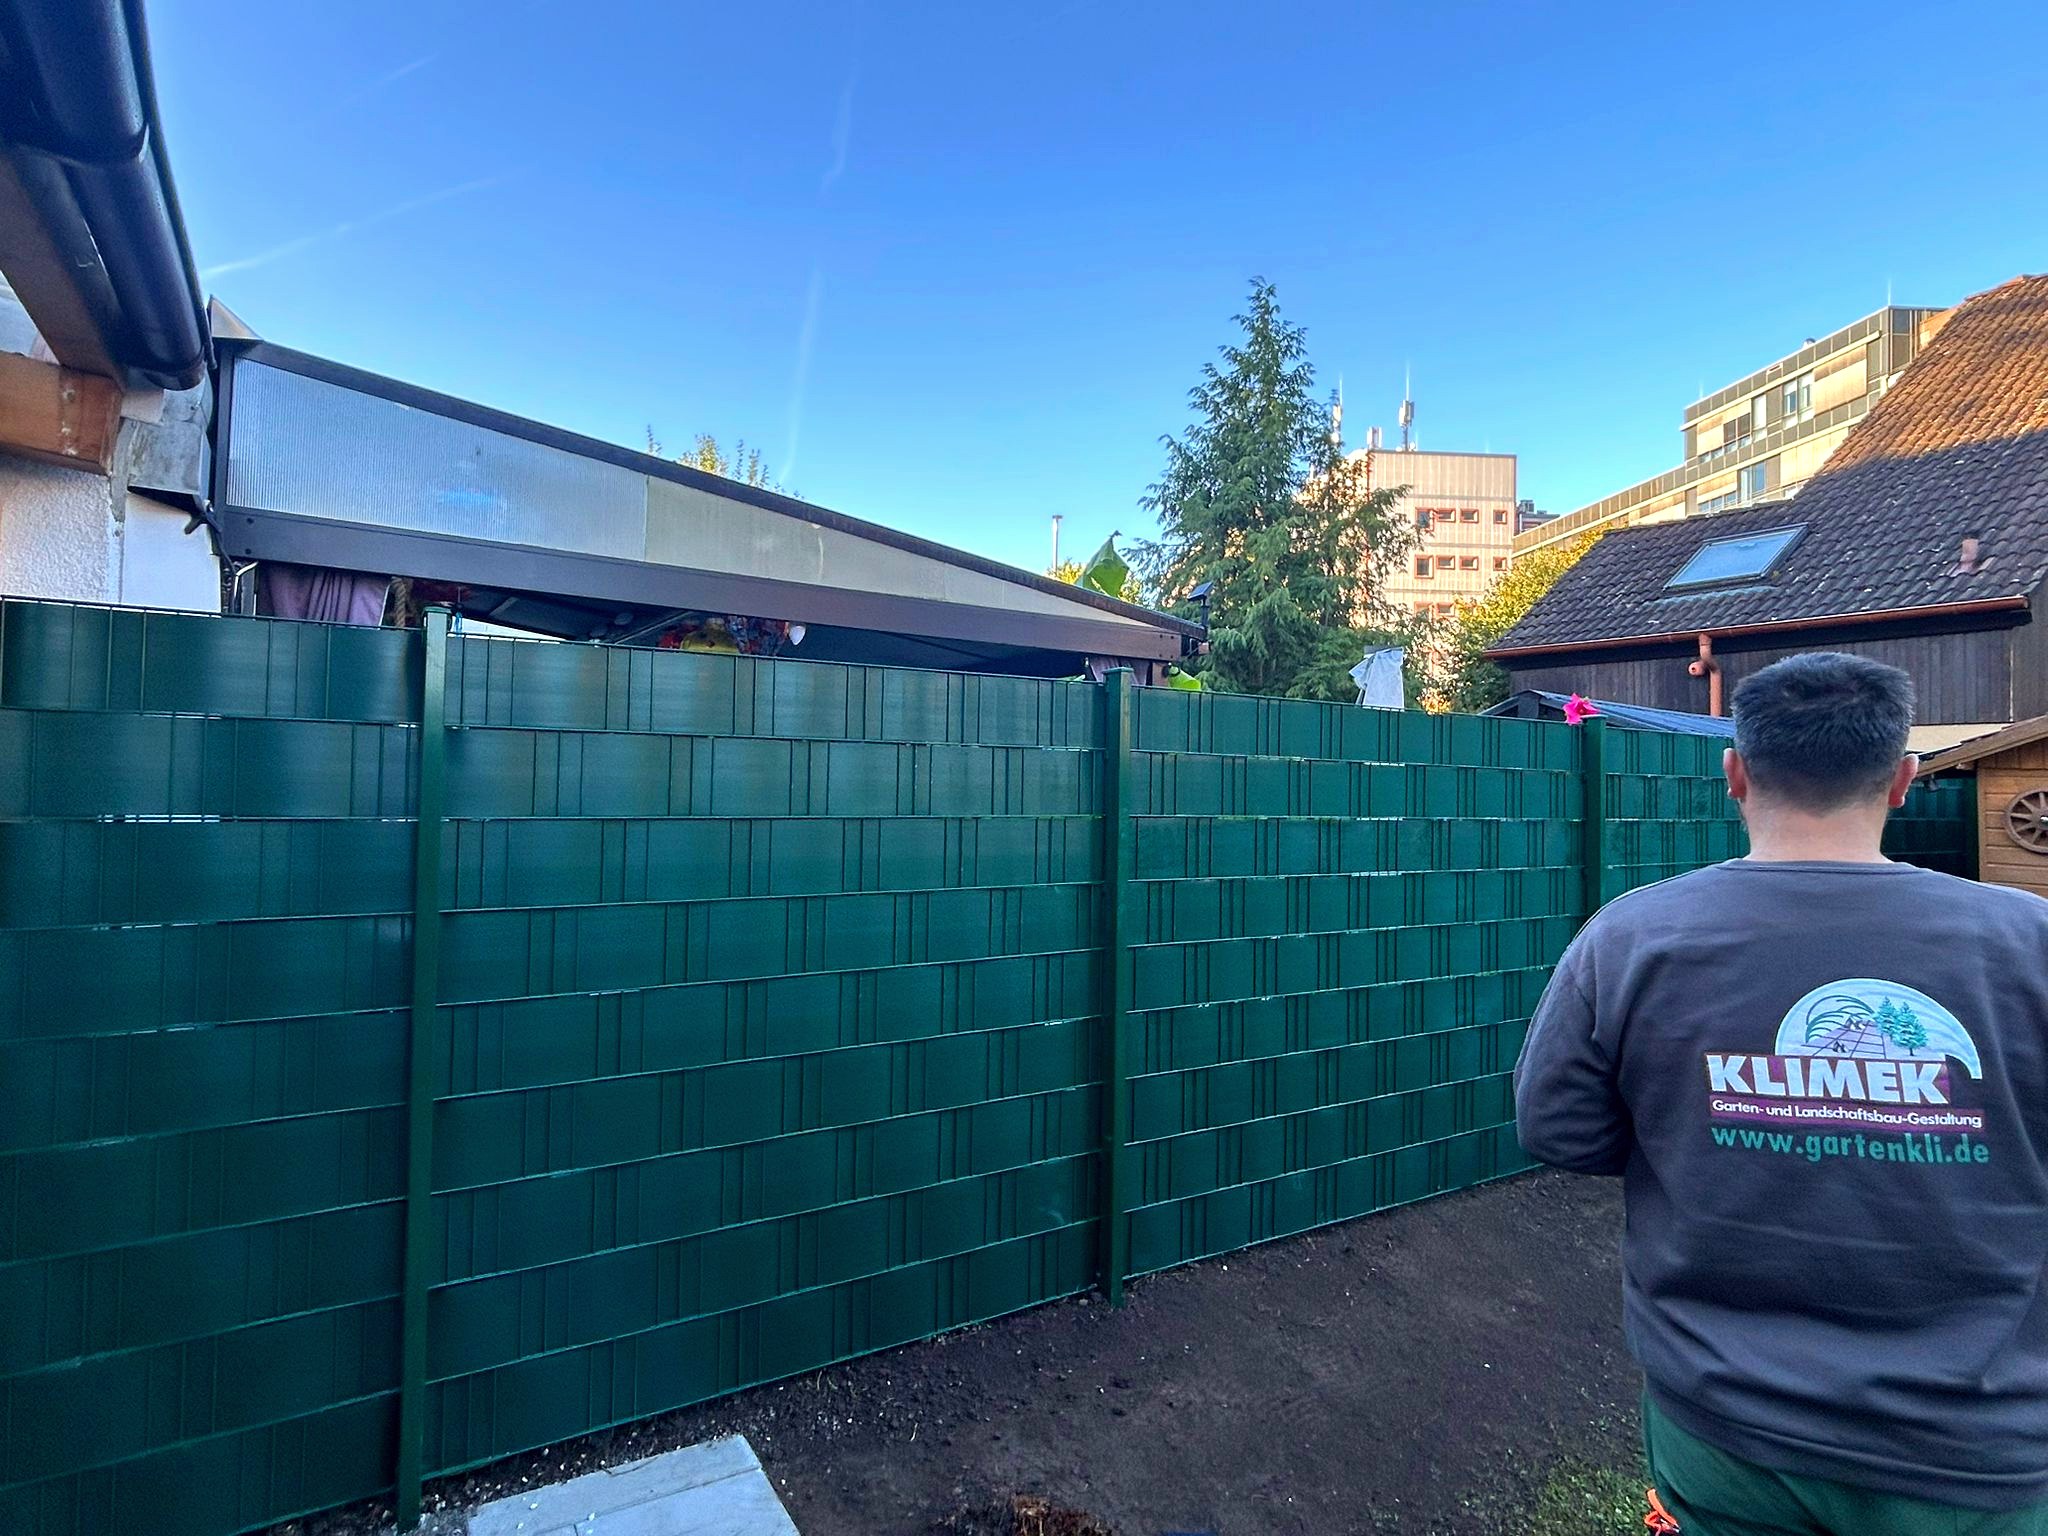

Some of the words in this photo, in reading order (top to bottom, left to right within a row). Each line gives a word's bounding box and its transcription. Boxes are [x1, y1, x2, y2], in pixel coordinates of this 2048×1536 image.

[1705, 1054, 1949, 1104] KLIMEK
[1711, 1099, 1764, 1115] Garten-
[1766, 1104, 1793, 1117] und
[1795, 1105, 1982, 1128] Landschaftsbau-Gestaltung
[1711, 1127, 1990, 1164] www.gartenkli.de
